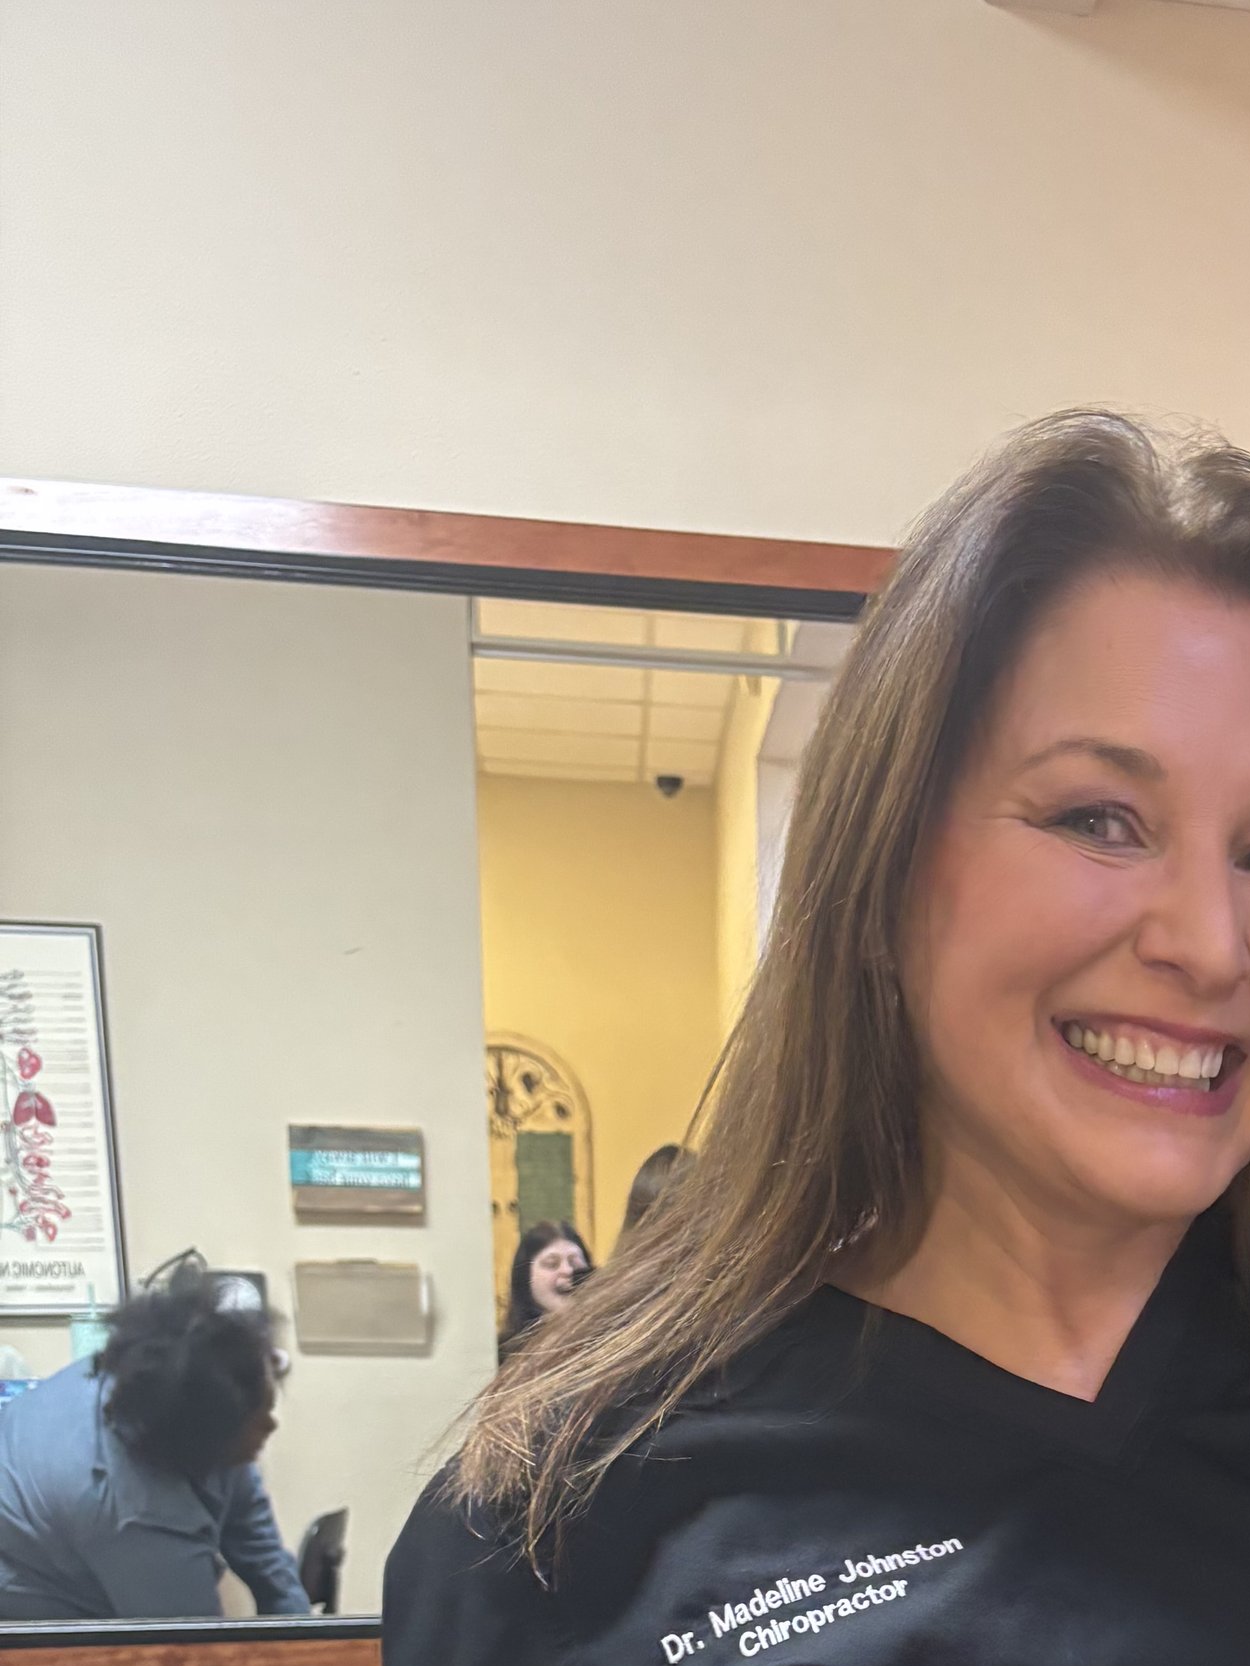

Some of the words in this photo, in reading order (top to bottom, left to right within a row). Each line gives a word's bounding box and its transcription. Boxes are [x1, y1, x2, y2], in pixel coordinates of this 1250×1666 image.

[660, 1631, 705, 1665] Dr.
[708, 1574, 827, 1638] Madeline
[838, 1537, 964, 1584] Johnston
[738, 1578, 909, 1658] Chiropractor
